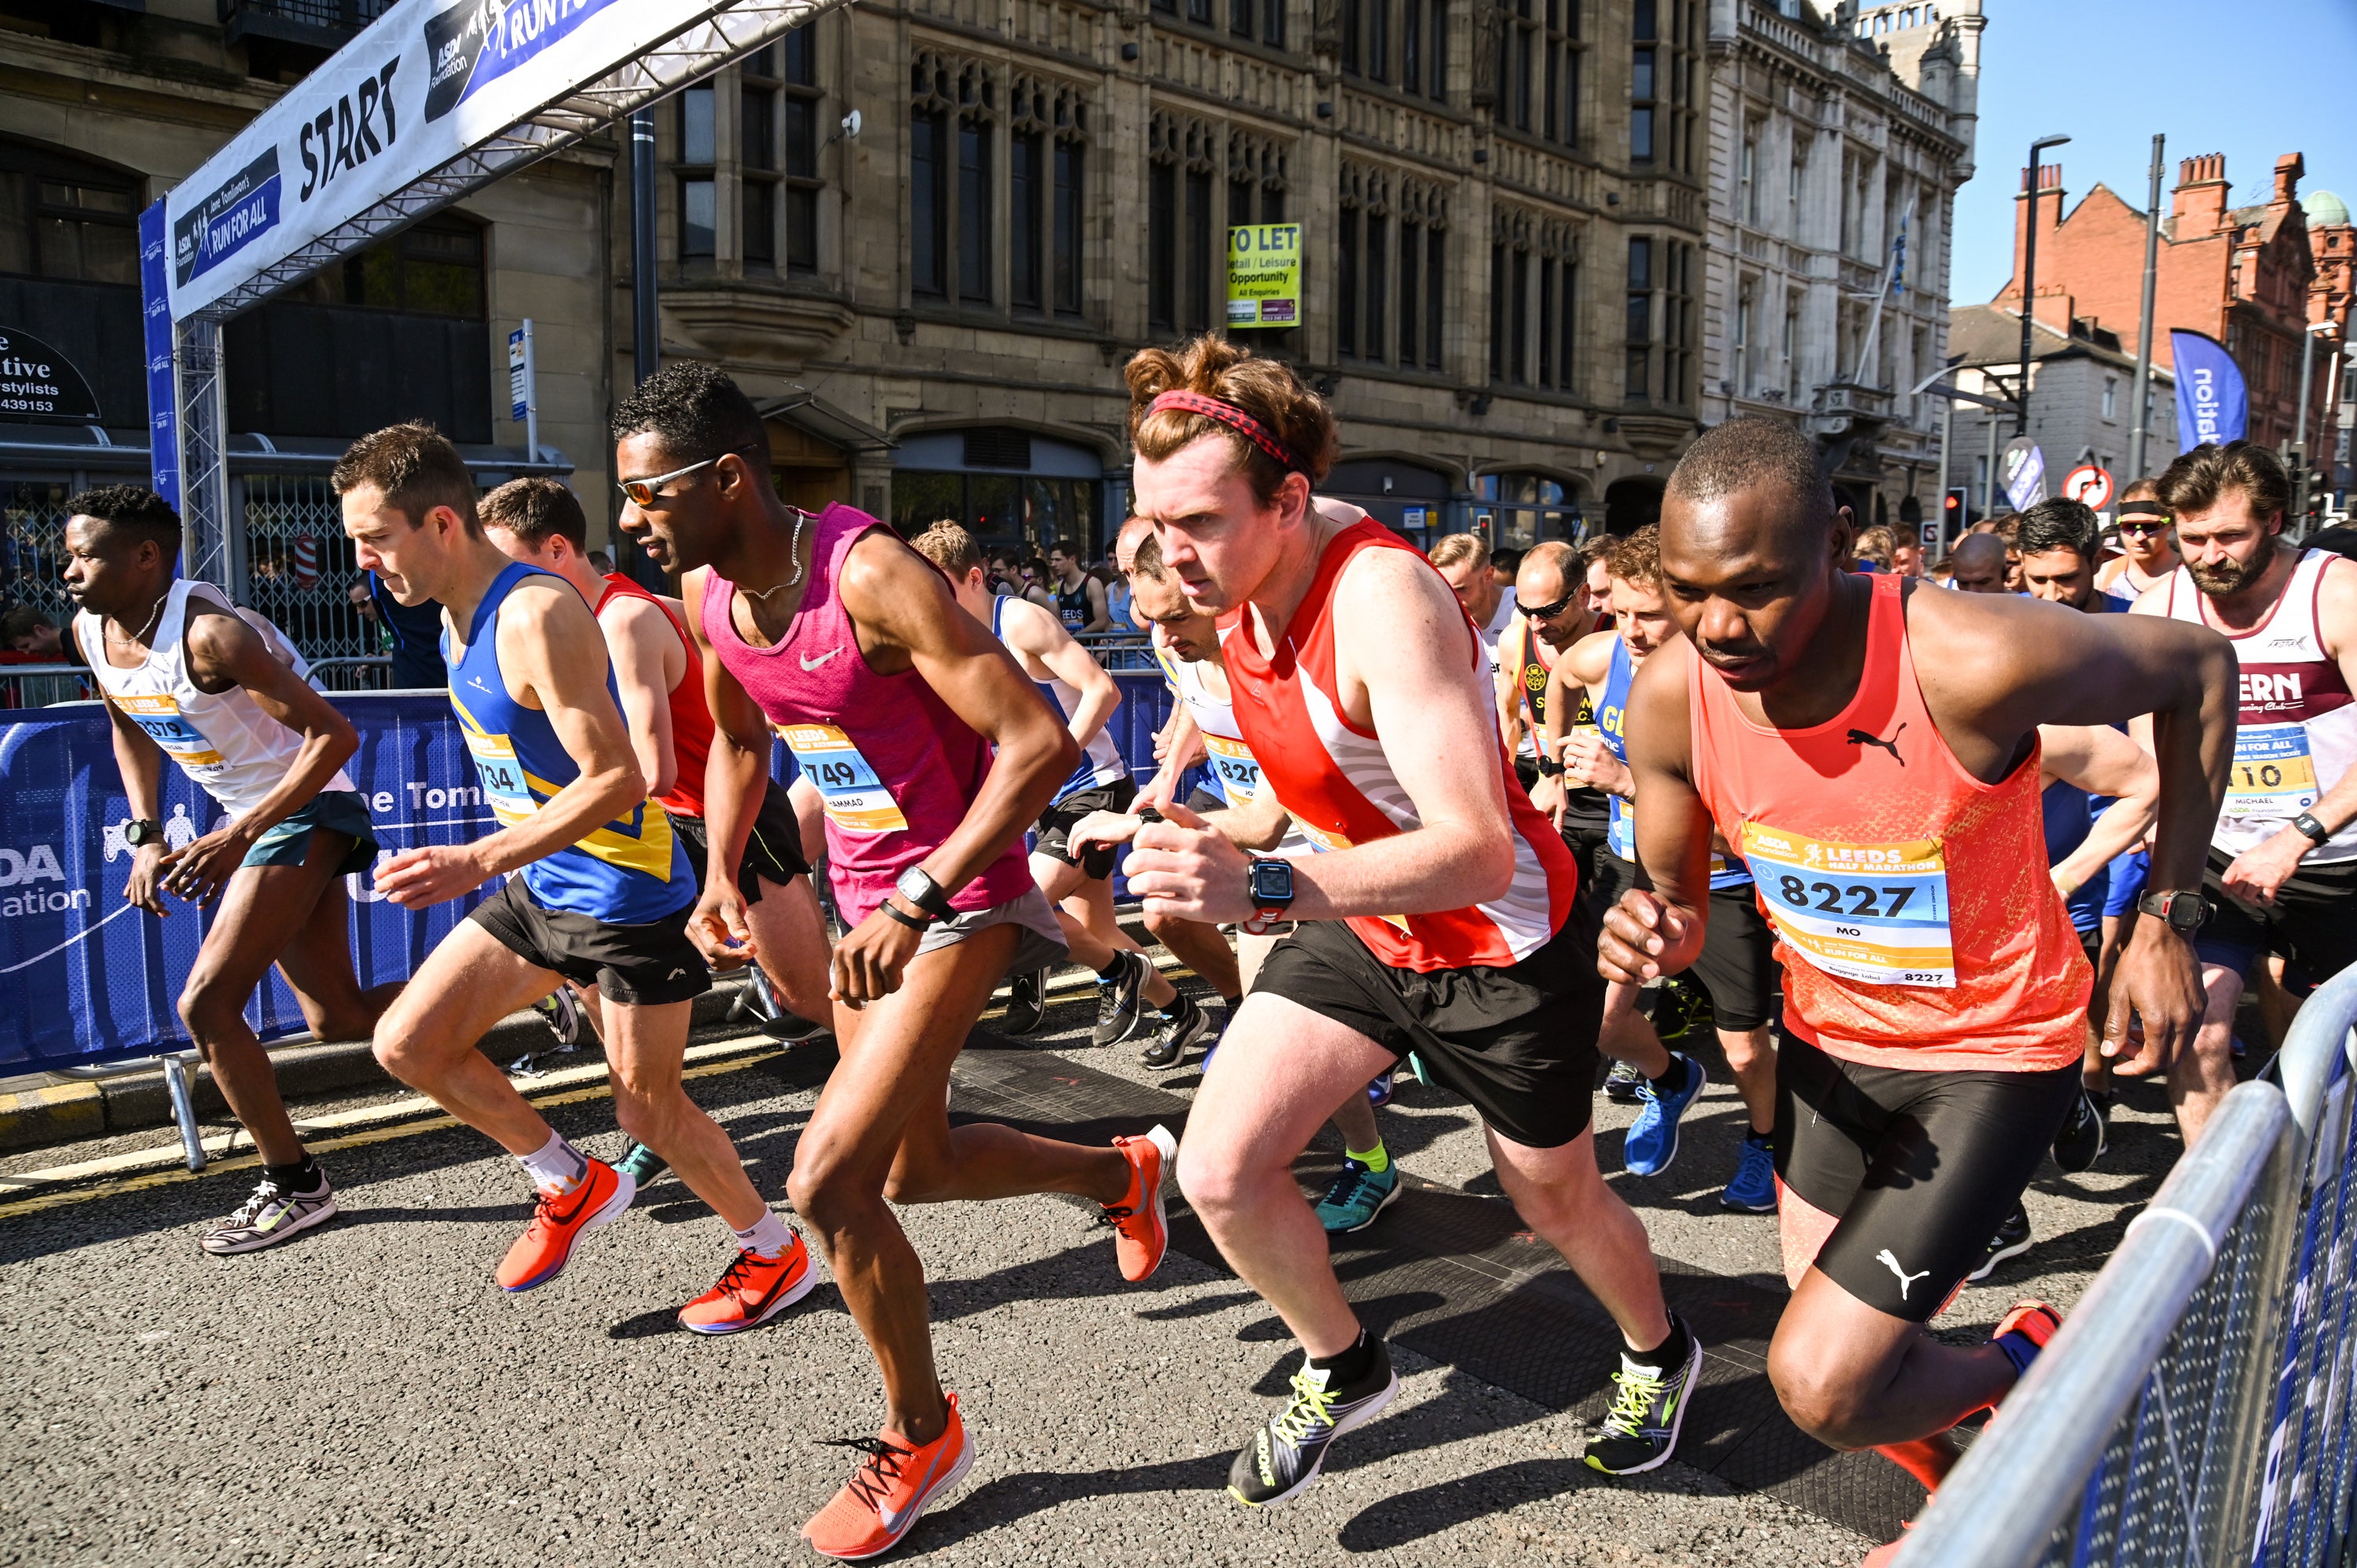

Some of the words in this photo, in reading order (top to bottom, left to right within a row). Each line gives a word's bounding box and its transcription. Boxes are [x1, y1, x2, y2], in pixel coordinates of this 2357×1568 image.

[430, 56, 467, 91] Foundation
[300, 53, 401, 203] START
[211, 198, 221, 214] Jane
[221, 174, 250, 205] Tomlinson's
[211, 221, 231, 255] RUN
[231, 209, 249, 243] FOR
[249, 196, 267, 229] ALL
[178, 234, 192, 256] ASDA
[1227, 229, 1251, 251] TO
[1259, 227, 1297, 251] LET
[176, 251, 194, 268] Foundation
[1259, 256, 1296, 268] Leisure
[1230, 271, 1288, 285] Opportunity
[1249, 288, 1280, 298] Enquiries
[0, 357, 50, 378] tive
[0, 399, 53, 412] 439153
[2239, 672, 2303, 702] ERN
[2264, 702, 2286, 711] Club
[790, 728, 829, 742] LEEDS
[2249, 742, 2270, 752] FOR
[2272, 741, 2293, 750] ALL
[801, 762, 855, 786] 749
[407, 781, 491, 809] Tom
[1752, 843, 1798, 859] Foundation
[1757, 834, 1792, 852] ASDA
[1827, 848, 1902, 864] LEEDS
[1828, 862, 1860, 871] HALF
[1863, 861, 1936, 872] MARATHON
[0, 887, 91, 918] ation
[1780, 875, 1916, 918] 8227
[1836, 926, 1861, 936] MO
[1824, 947, 1847, 958] RUN
[1847, 951, 1868, 961] FOR
[1869, 954, 1889, 964] ALL
[1828, 965, 1859, 977] Baggage
[1904, 973, 1943, 982] 8227
[1257, 1427, 1276, 1486] BROOKS
